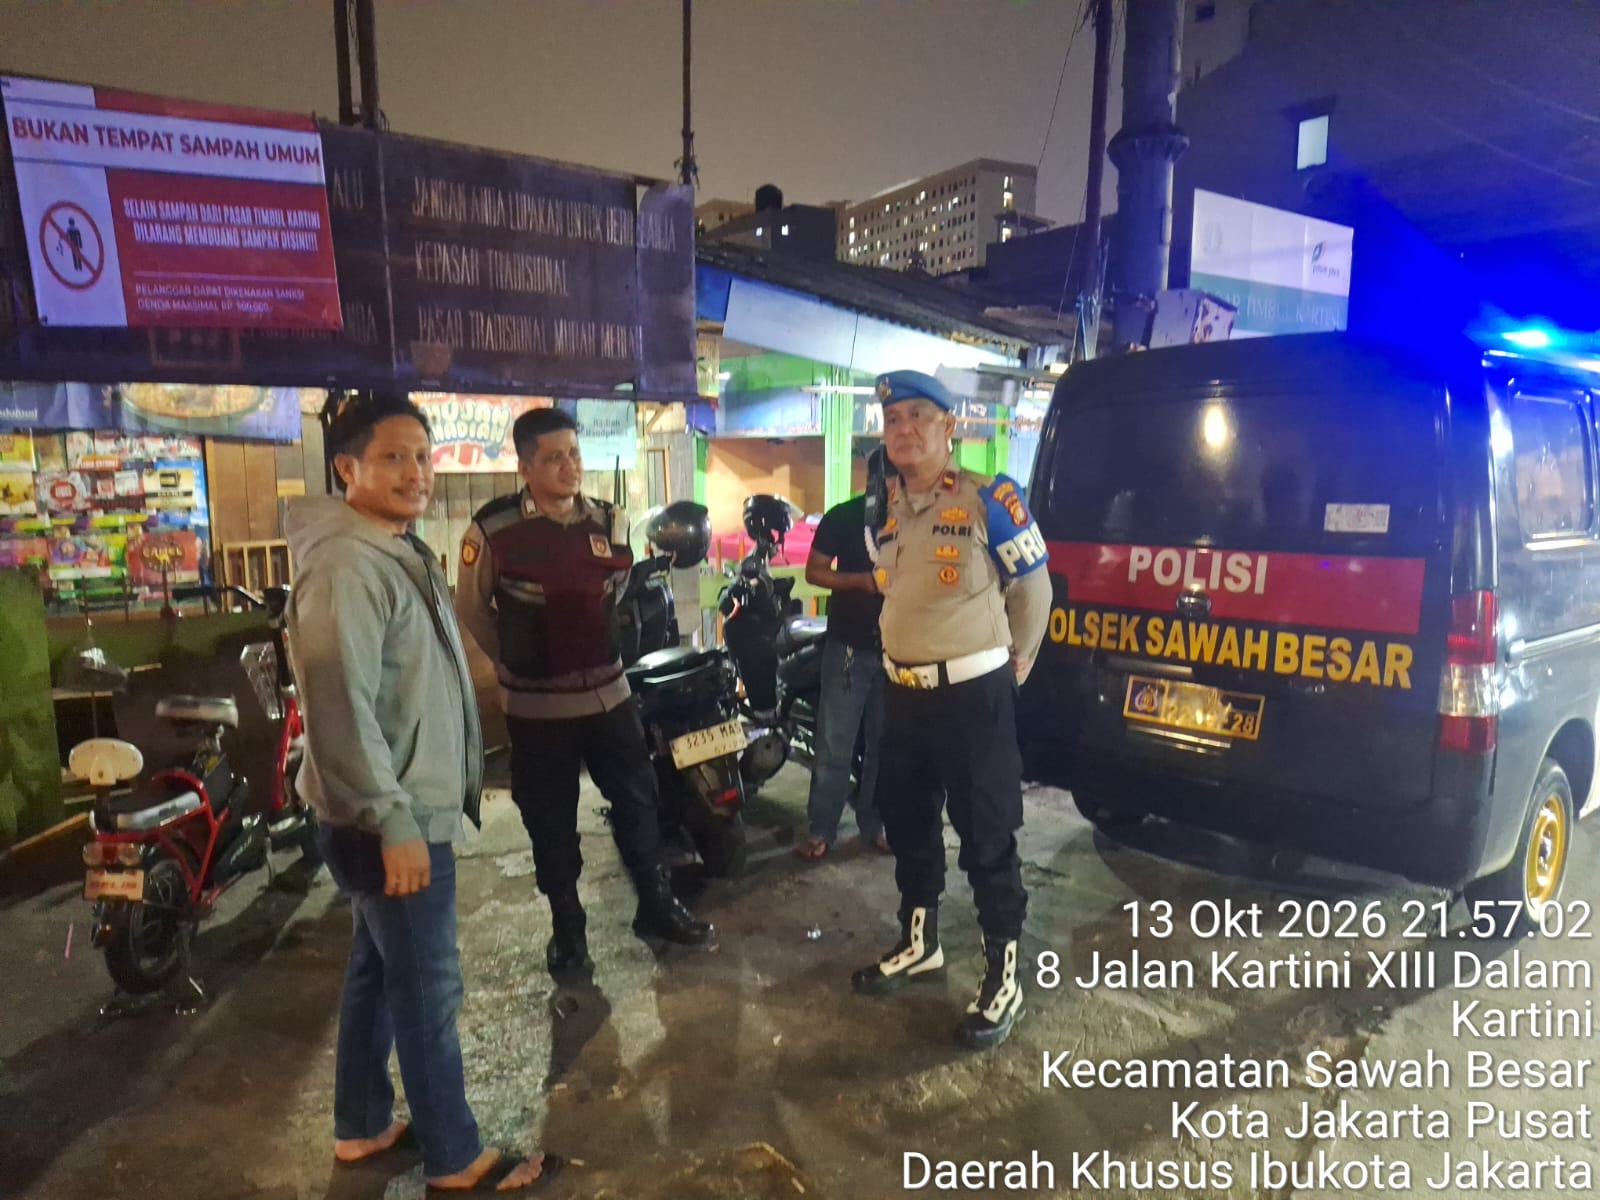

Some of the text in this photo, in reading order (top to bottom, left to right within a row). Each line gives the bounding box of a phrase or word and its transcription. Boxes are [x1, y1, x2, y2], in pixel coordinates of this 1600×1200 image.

[12, 116, 321, 166] BUKAN TEMPAT SAMPAH UMUM
[123, 198, 321, 230] SELAIN SAMPAH DARI PASAR TIMBUL KARTINI
[133, 221, 183, 244] DILARANG
[183, 224, 240, 247] MEMBUANG
[241, 228, 280, 250] SAMPAH
[487, 248, 569, 297] TRADISIONAL
[932, 524, 972, 538] POLRI
[1128, 545, 1268, 595] POLISI
[1050, 607, 1414, 690] OLSEK SAWAH BESAR
